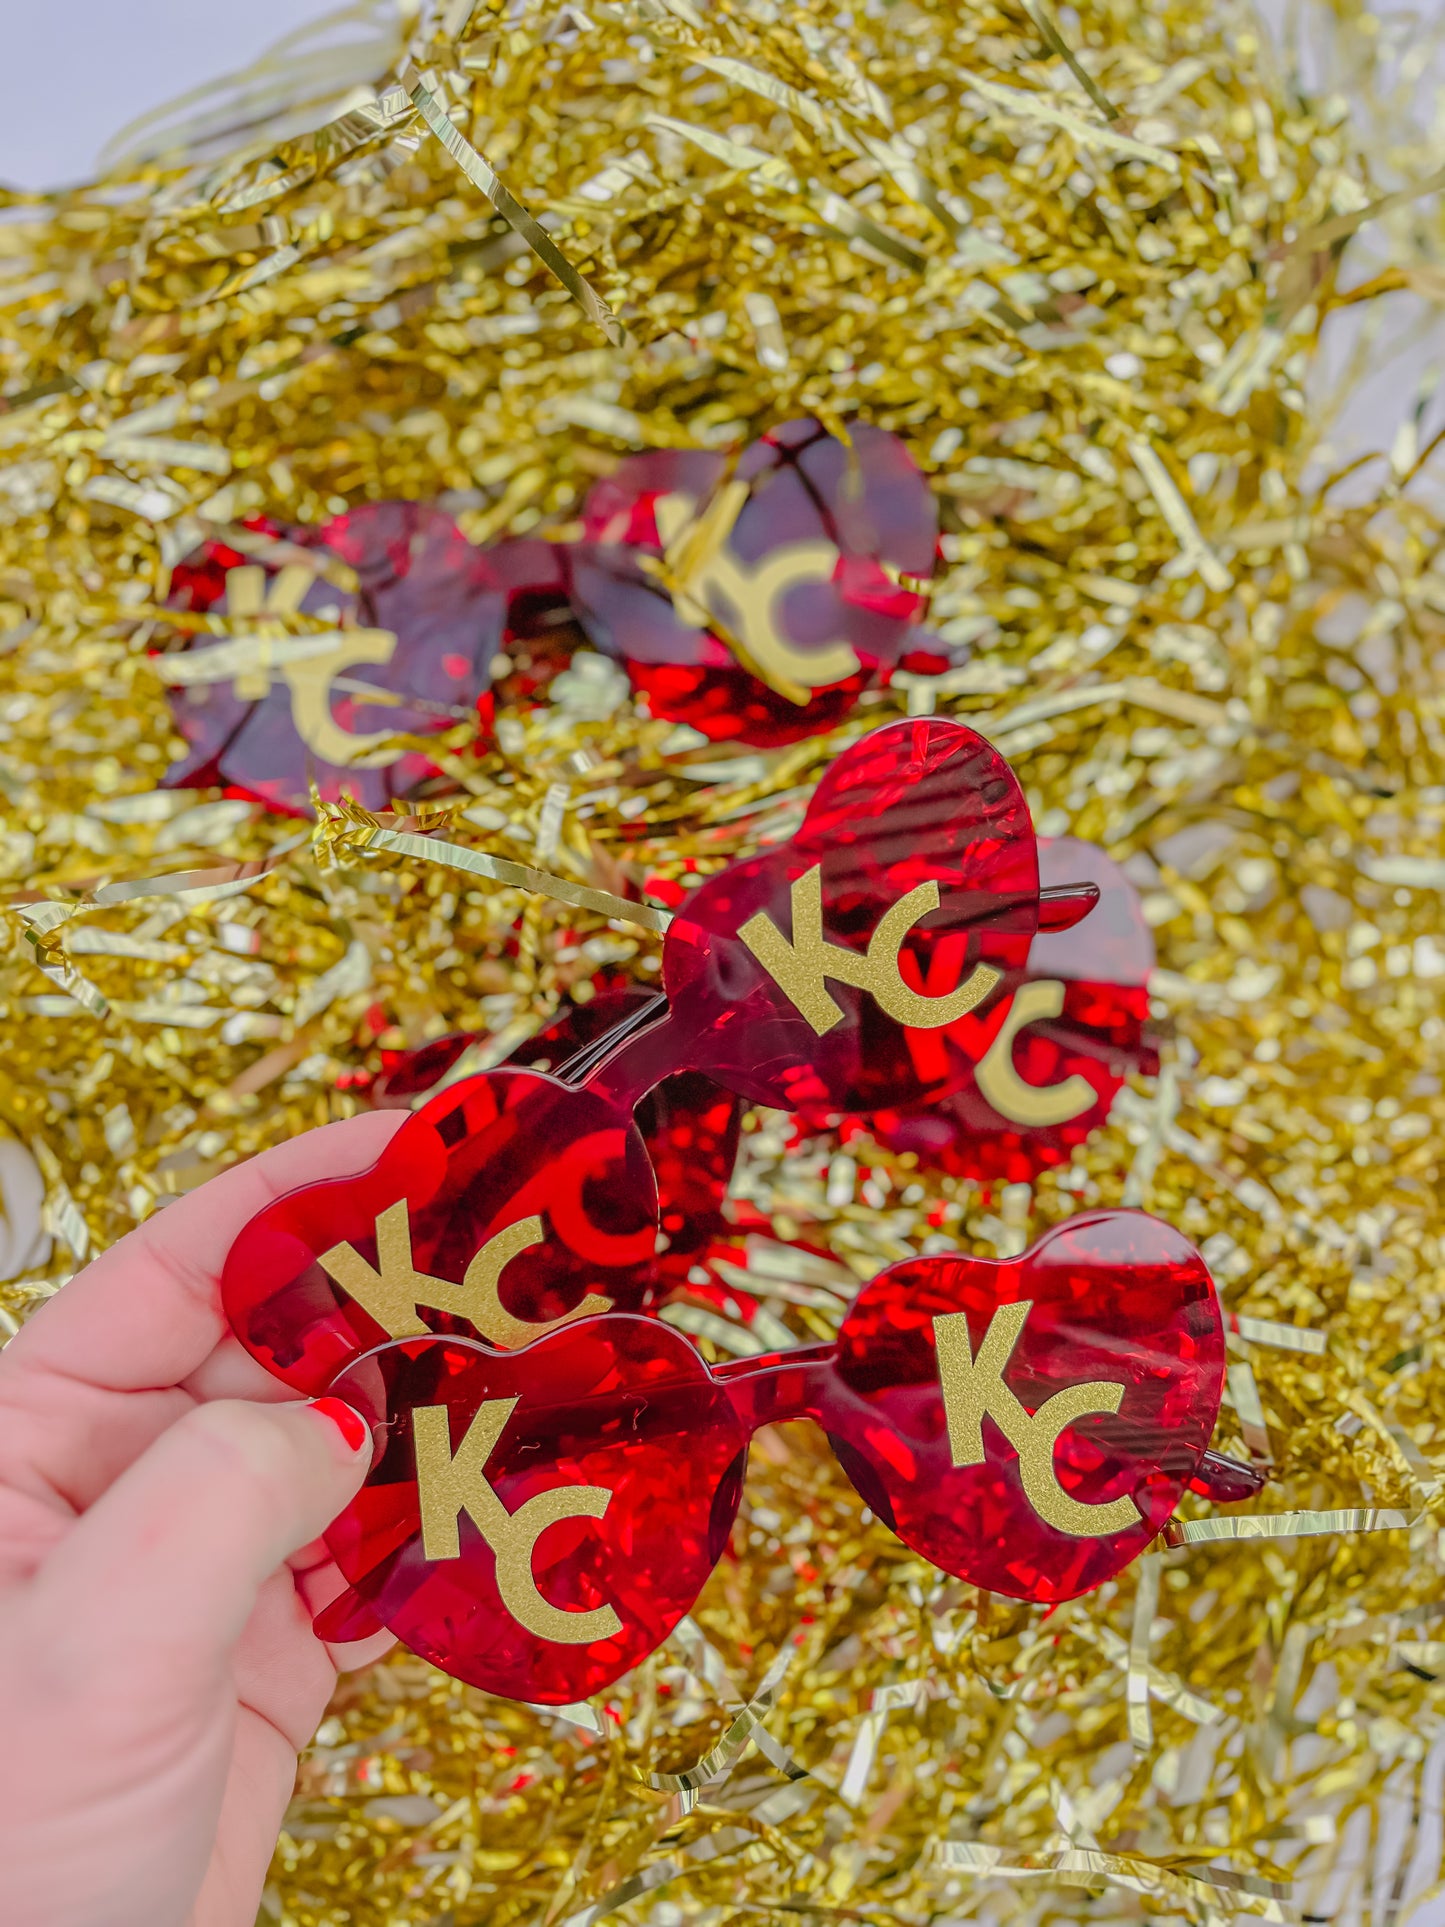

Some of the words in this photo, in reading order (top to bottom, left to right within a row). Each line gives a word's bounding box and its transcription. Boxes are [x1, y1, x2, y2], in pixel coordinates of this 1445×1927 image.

[225, 565, 399, 768] KC
[654, 480, 862, 687] KC
[737, 864, 1001, 1036] KC
[317, 1198, 614, 1349] KC
[412, 1396, 623, 1644] KC
[932, 1300, 1142, 1536] KC
